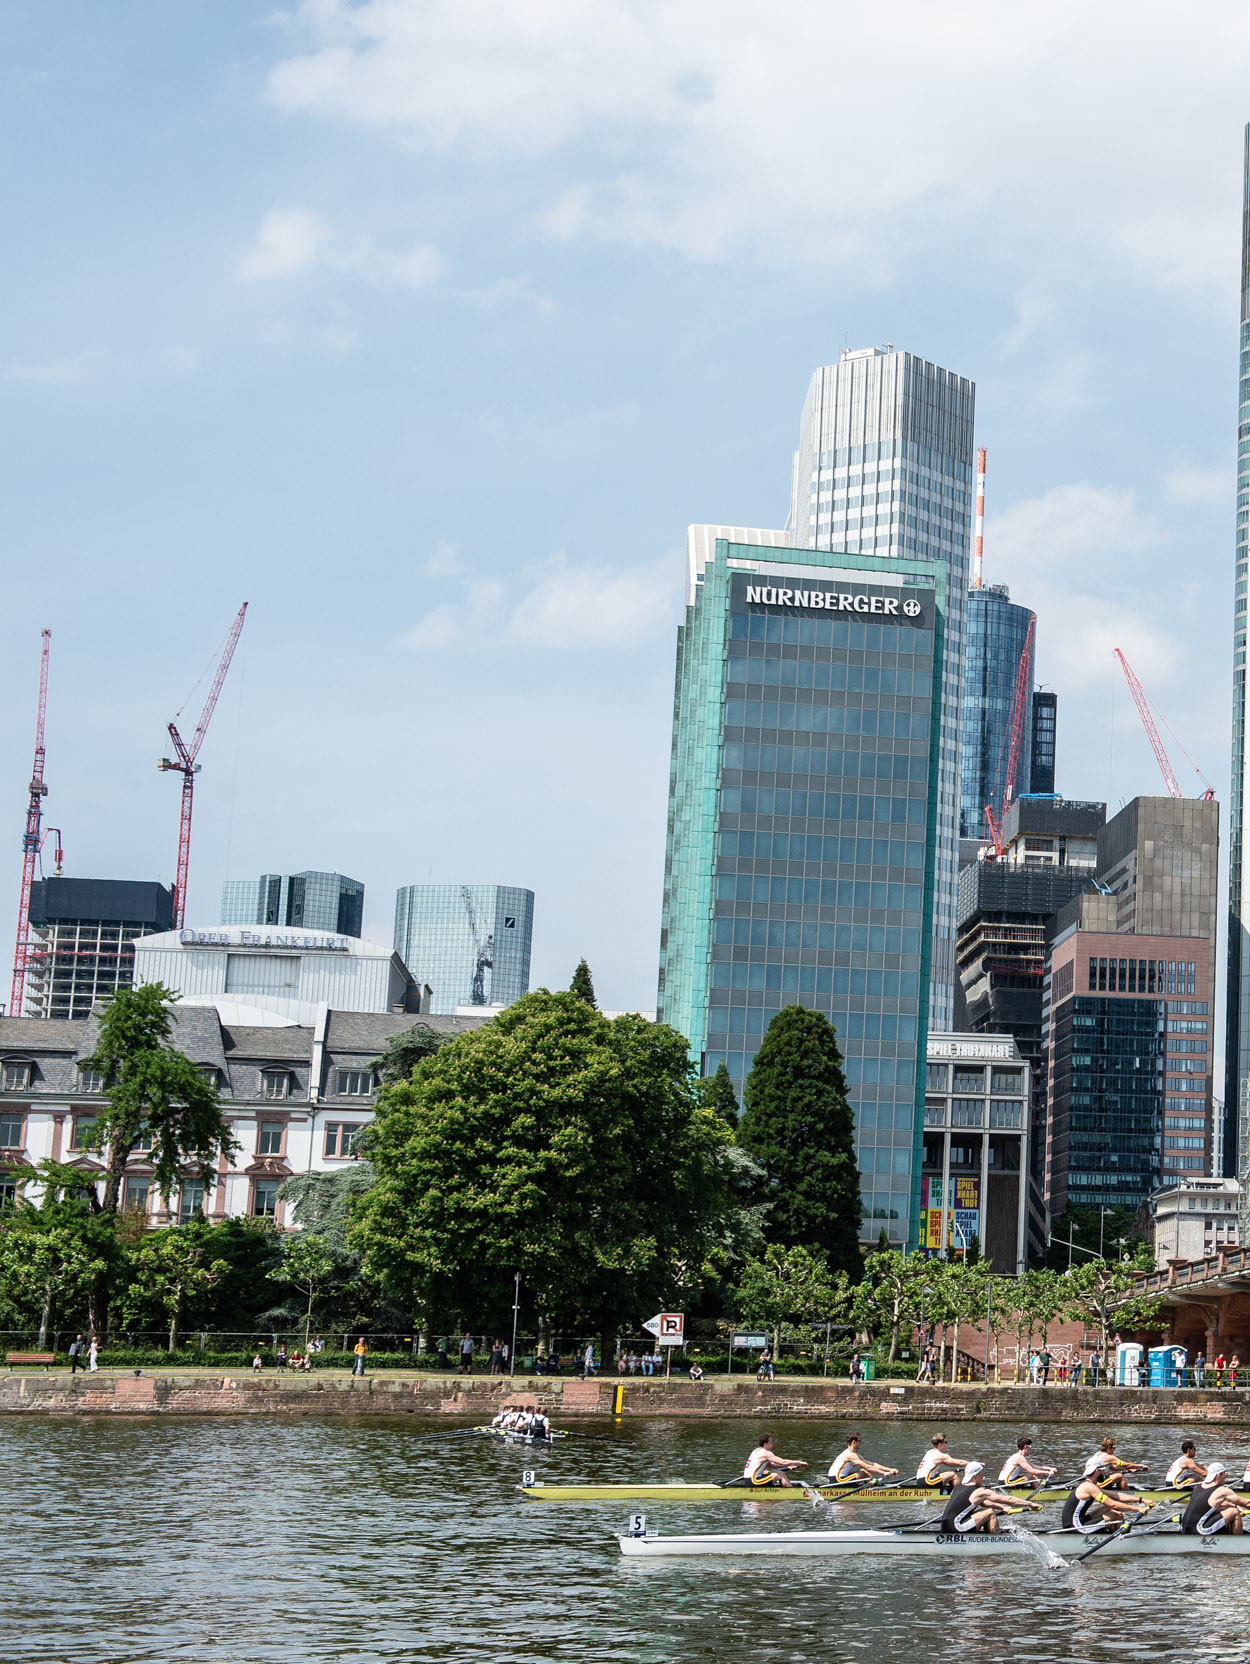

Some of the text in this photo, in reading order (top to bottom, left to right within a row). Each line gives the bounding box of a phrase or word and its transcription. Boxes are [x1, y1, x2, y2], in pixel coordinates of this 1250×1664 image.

[746, 585, 899, 616] NÜRNBERGER
[179, 928, 349, 950] OPER FRANKFURT
[956, 1181, 974, 1190] SPIEL
[955, 1211, 977, 1220] SCHAU
[899, 1489, 913, 1497] der
[913, 1489, 932, 1497] Ruhr
[633, 1515, 642, 1531] 5
[946, 1534, 967, 1543] RBL
